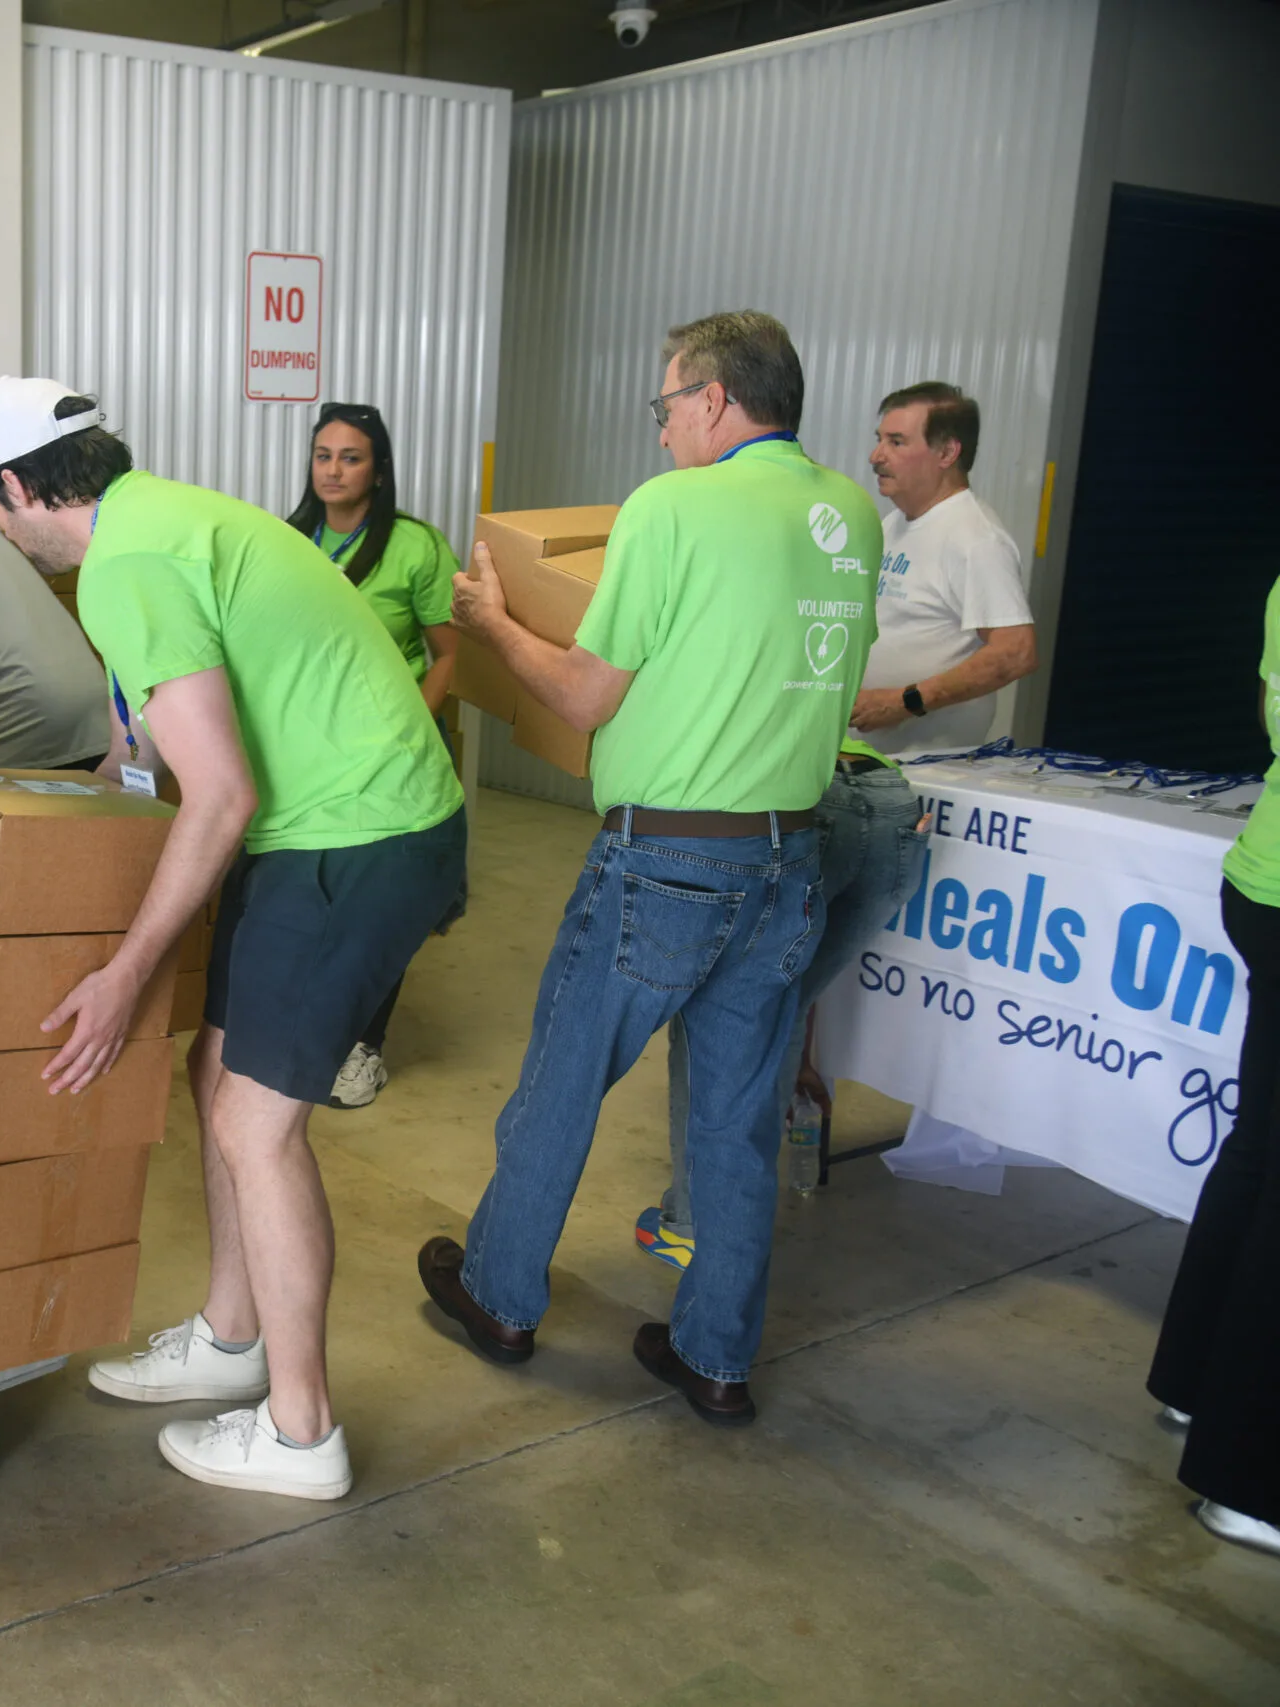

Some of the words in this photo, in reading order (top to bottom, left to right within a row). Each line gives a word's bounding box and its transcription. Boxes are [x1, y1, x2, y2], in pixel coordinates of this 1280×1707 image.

[264, 286, 305, 324] NO
[250, 350, 316, 370] DUMPING
[832, 557, 869, 575] FPL
[892, 552, 910, 575] On
[797, 599, 863, 619] VOLUNTEER
[964, 807, 1032, 855] ARE
[1111, 902, 1235, 1036] On
[920, 975, 975, 1021] no
[997, 999, 1163, 1079] senior
